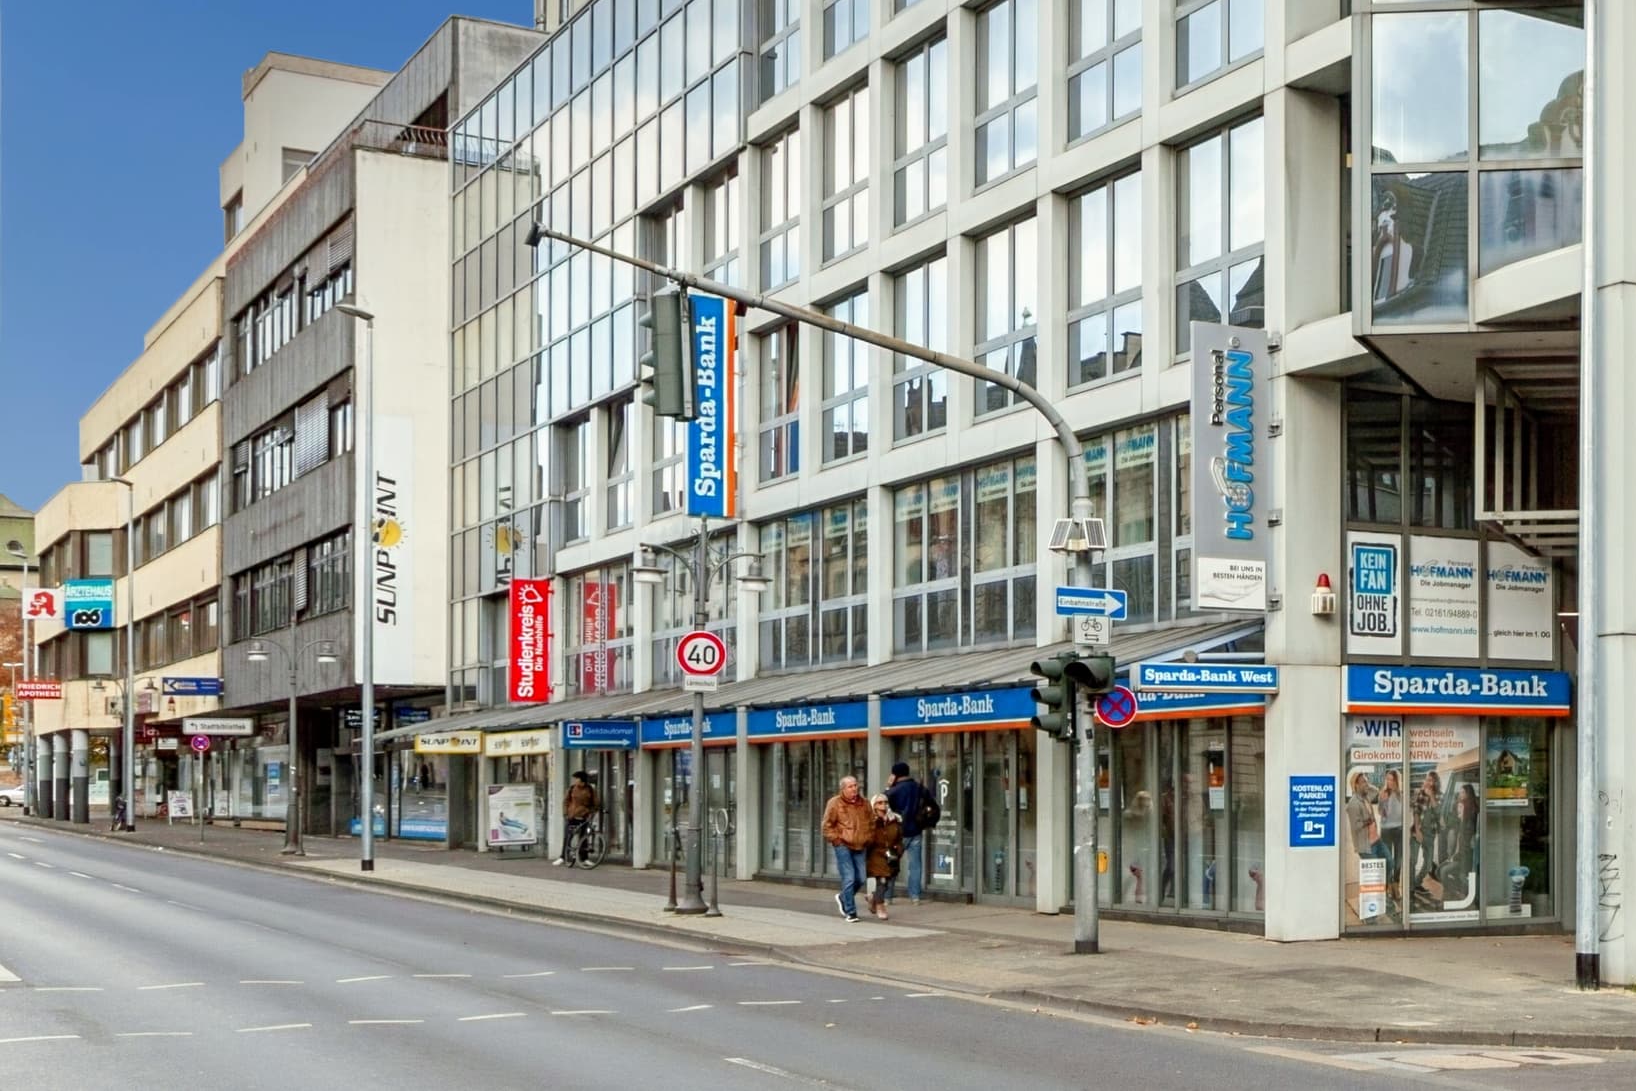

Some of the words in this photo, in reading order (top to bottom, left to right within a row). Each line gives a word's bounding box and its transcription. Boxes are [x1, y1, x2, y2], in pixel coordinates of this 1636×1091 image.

[1210, 349, 1224, 426] Personal
[694, 316, 722, 497] Sparda-Bank
[1229, 565, 1240, 573] BEI
[1240, 565, 1254, 573] UNS
[1255, 565, 1263, 573] IN
[1360, 552, 1387, 570] KEIN
[1212, 573, 1235, 581] BESTEN
[1236, 572, 1263, 582] HÄNDEN
[1360, 570, 1387, 590] FAN
[1431, 580, 1471, 590] Jobmanager
[1506, 586, 1545, 594] Jobmanager
[1059, 597, 1107, 608] Einbahnstraße
[1356, 594, 1388, 612] OHNE
[1357, 613, 1391, 632] JOB.
[534, 615, 544, 657] Nachhilfe
[1512, 630, 1525, 638] hier
[517, 604, 535, 698] Studienkreis
[687, 644, 716, 665] 40
[534, 656, 544, 672] Die
[1144, 669, 1236, 684] Sparda-Bank
[1239, 670, 1273, 684] West
[1374, 670, 1548, 699] Sparda-Bank
[917, 694, 994, 720] Sparda-Bank
[664, 718, 712, 739] Sparda-nk
[775, 708, 836, 732] Sparda-Bank
[583, 726, 633, 736] Geldautomat
[1409, 728, 1455, 738] wechseln
[1383, 738, 1401, 748] hier
[1409, 740, 1430, 749] zum
[1432, 739, 1464, 749] besten
[1353, 750, 1401, 760] Girokonto
